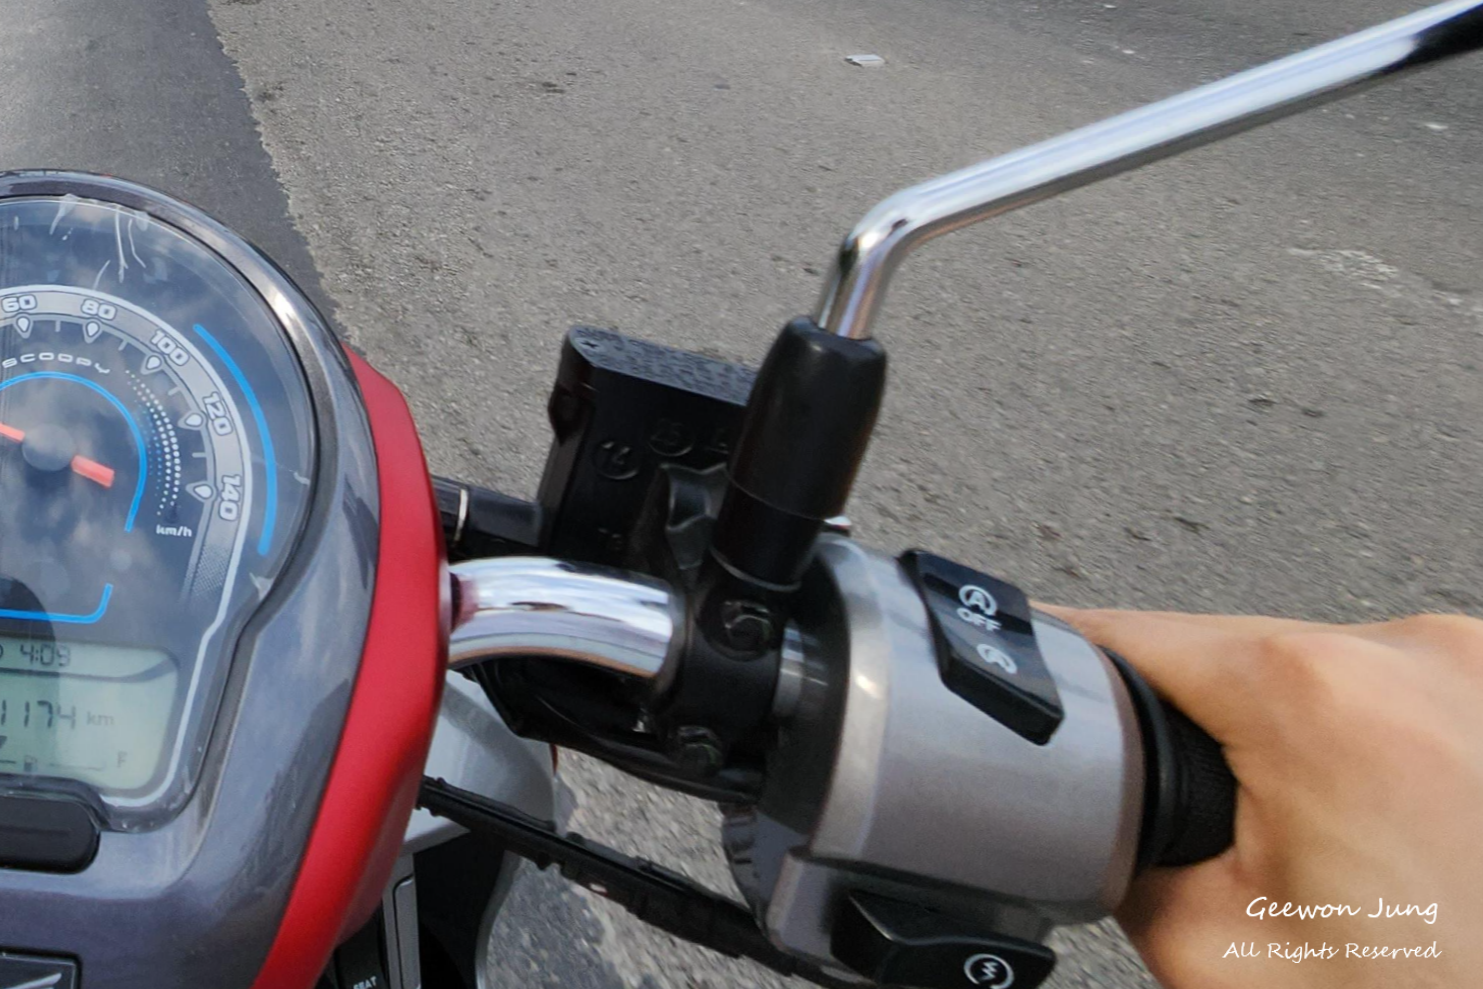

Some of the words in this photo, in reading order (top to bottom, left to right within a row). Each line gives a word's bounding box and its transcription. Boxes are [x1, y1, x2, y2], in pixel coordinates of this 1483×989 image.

[1, 294, 37, 313] 60
[80, 298, 116, 321] 80
[150, 329, 190, 366] 100
[2, 352, 110, 374] SCOOPY
[202, 392, 233, 436] 120
[219, 474, 241, 521] 140
[156, 524, 192, 538] km/h
[957, 607, 1002, 631] OFF
[0, 699, 76, 730] 1174
[86, 711, 115, 726] km
